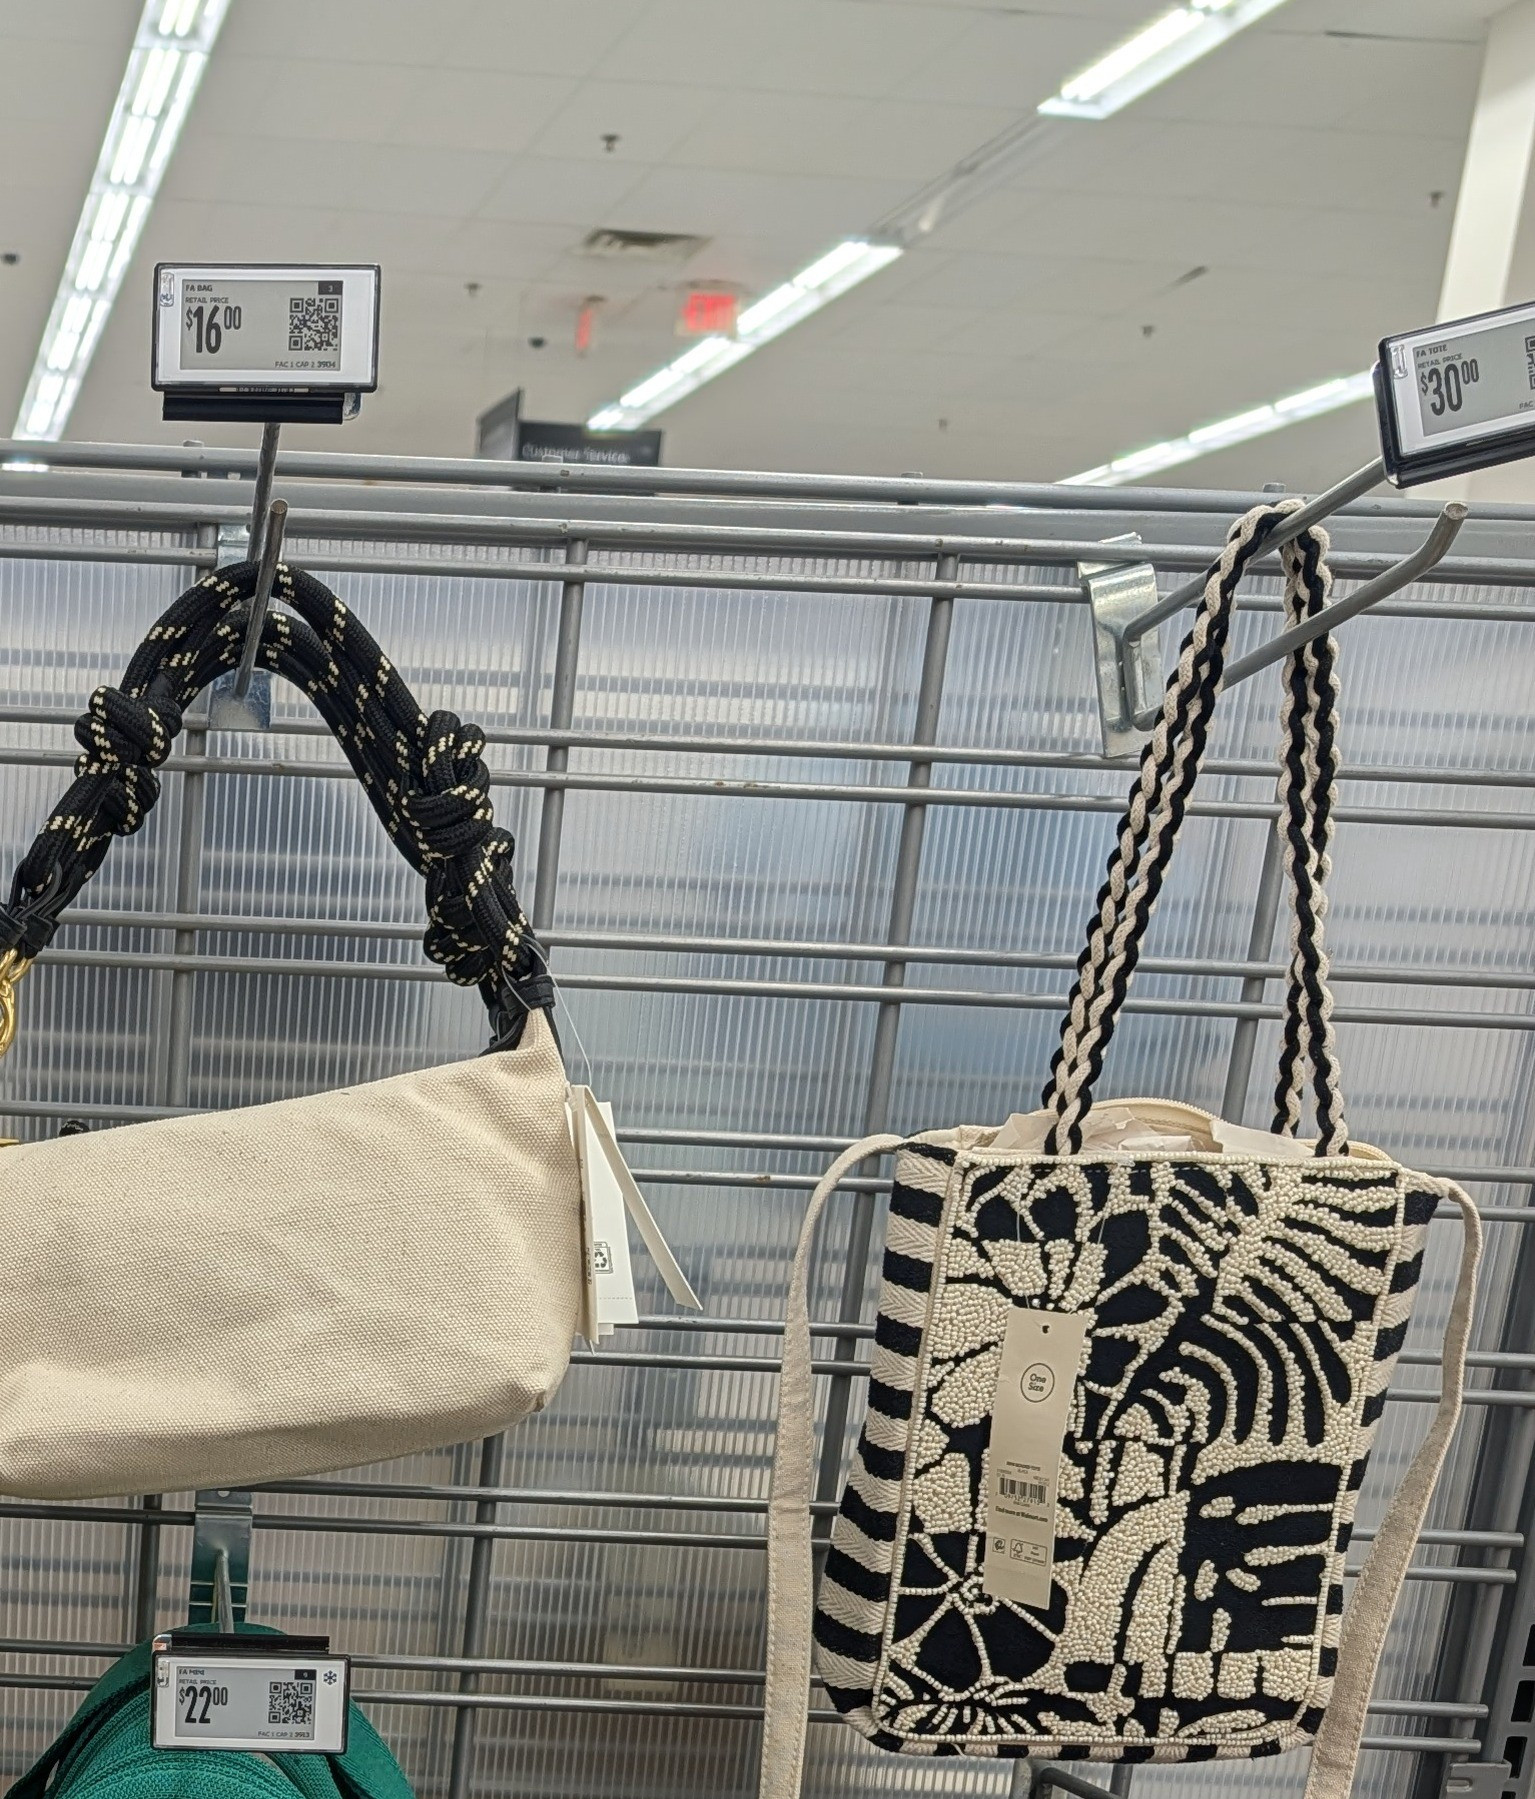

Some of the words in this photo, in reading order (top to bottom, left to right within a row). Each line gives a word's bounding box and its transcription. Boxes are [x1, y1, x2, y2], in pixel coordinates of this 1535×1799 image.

[197, 284, 213, 292] BAG
[1029, 1373, 1047, 1385] One
[1028, 1382, 1045, 1393] Size
